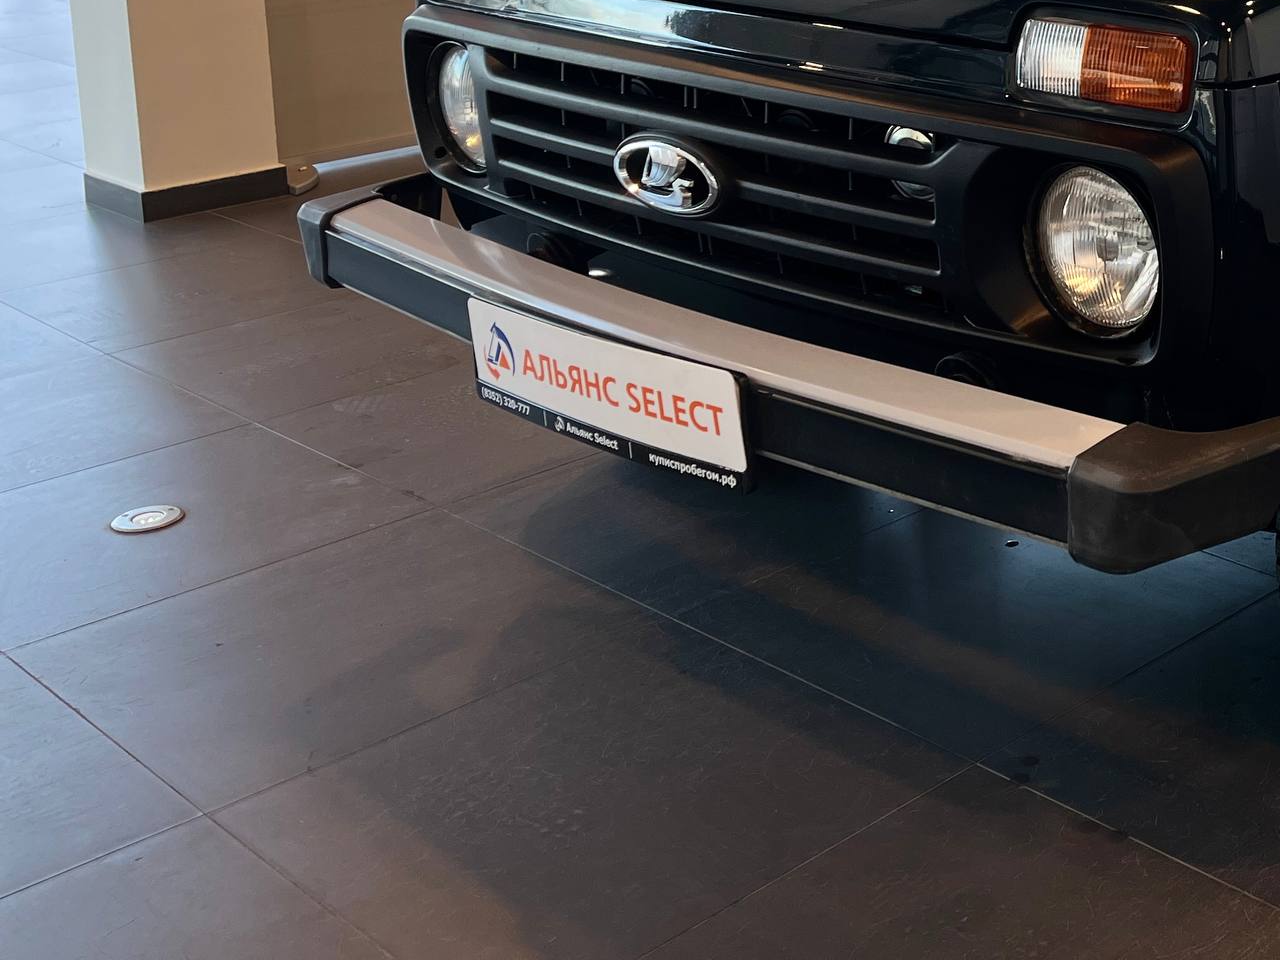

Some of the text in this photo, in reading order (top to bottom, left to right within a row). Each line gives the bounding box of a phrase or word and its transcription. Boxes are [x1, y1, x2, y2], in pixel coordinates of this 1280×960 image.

[481, 386, 530, 415] (8352) 320-777
[523, 349, 722, 436] АЛЬЯНС SELECT
[566, 422, 619, 450] Альянс Select
[648, 453, 737, 489] куписпробегом.рф
